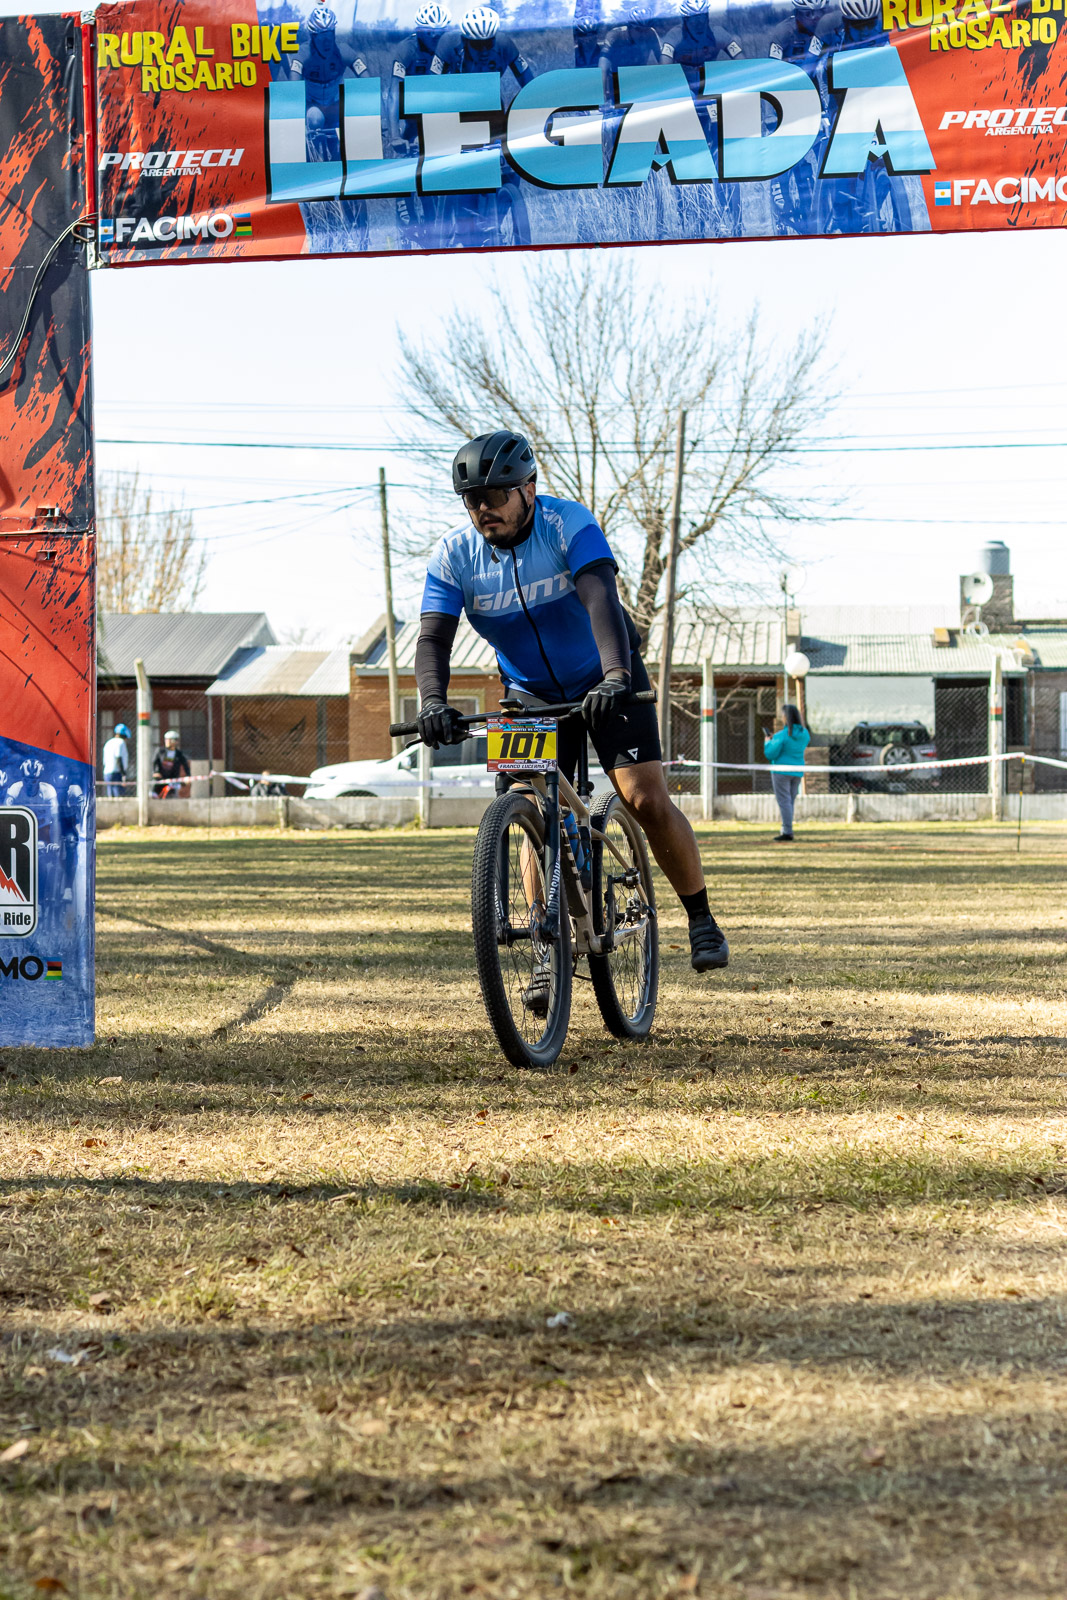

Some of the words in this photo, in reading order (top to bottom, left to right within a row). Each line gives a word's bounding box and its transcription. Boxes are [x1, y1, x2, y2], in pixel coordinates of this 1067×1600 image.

[97, 25, 215, 68] RURAL
[231, 22, 300, 62] BIKE
[930, 17, 1058, 50] ROSARIO
[141, 60, 258, 93] ROSARIO
[265, 46, 937, 203] LLEGADA
[985, 125, 1054, 136] ARGENTINA
[98, 148, 245, 171] PROTECH
[140, 167, 202, 177] ARGENTINA
[116, 213, 234, 242] FACIMO
[473, 570, 571, 611] GIANT
[500, 733, 547, 758] 101
[4, 912, 31, 926] Ride
